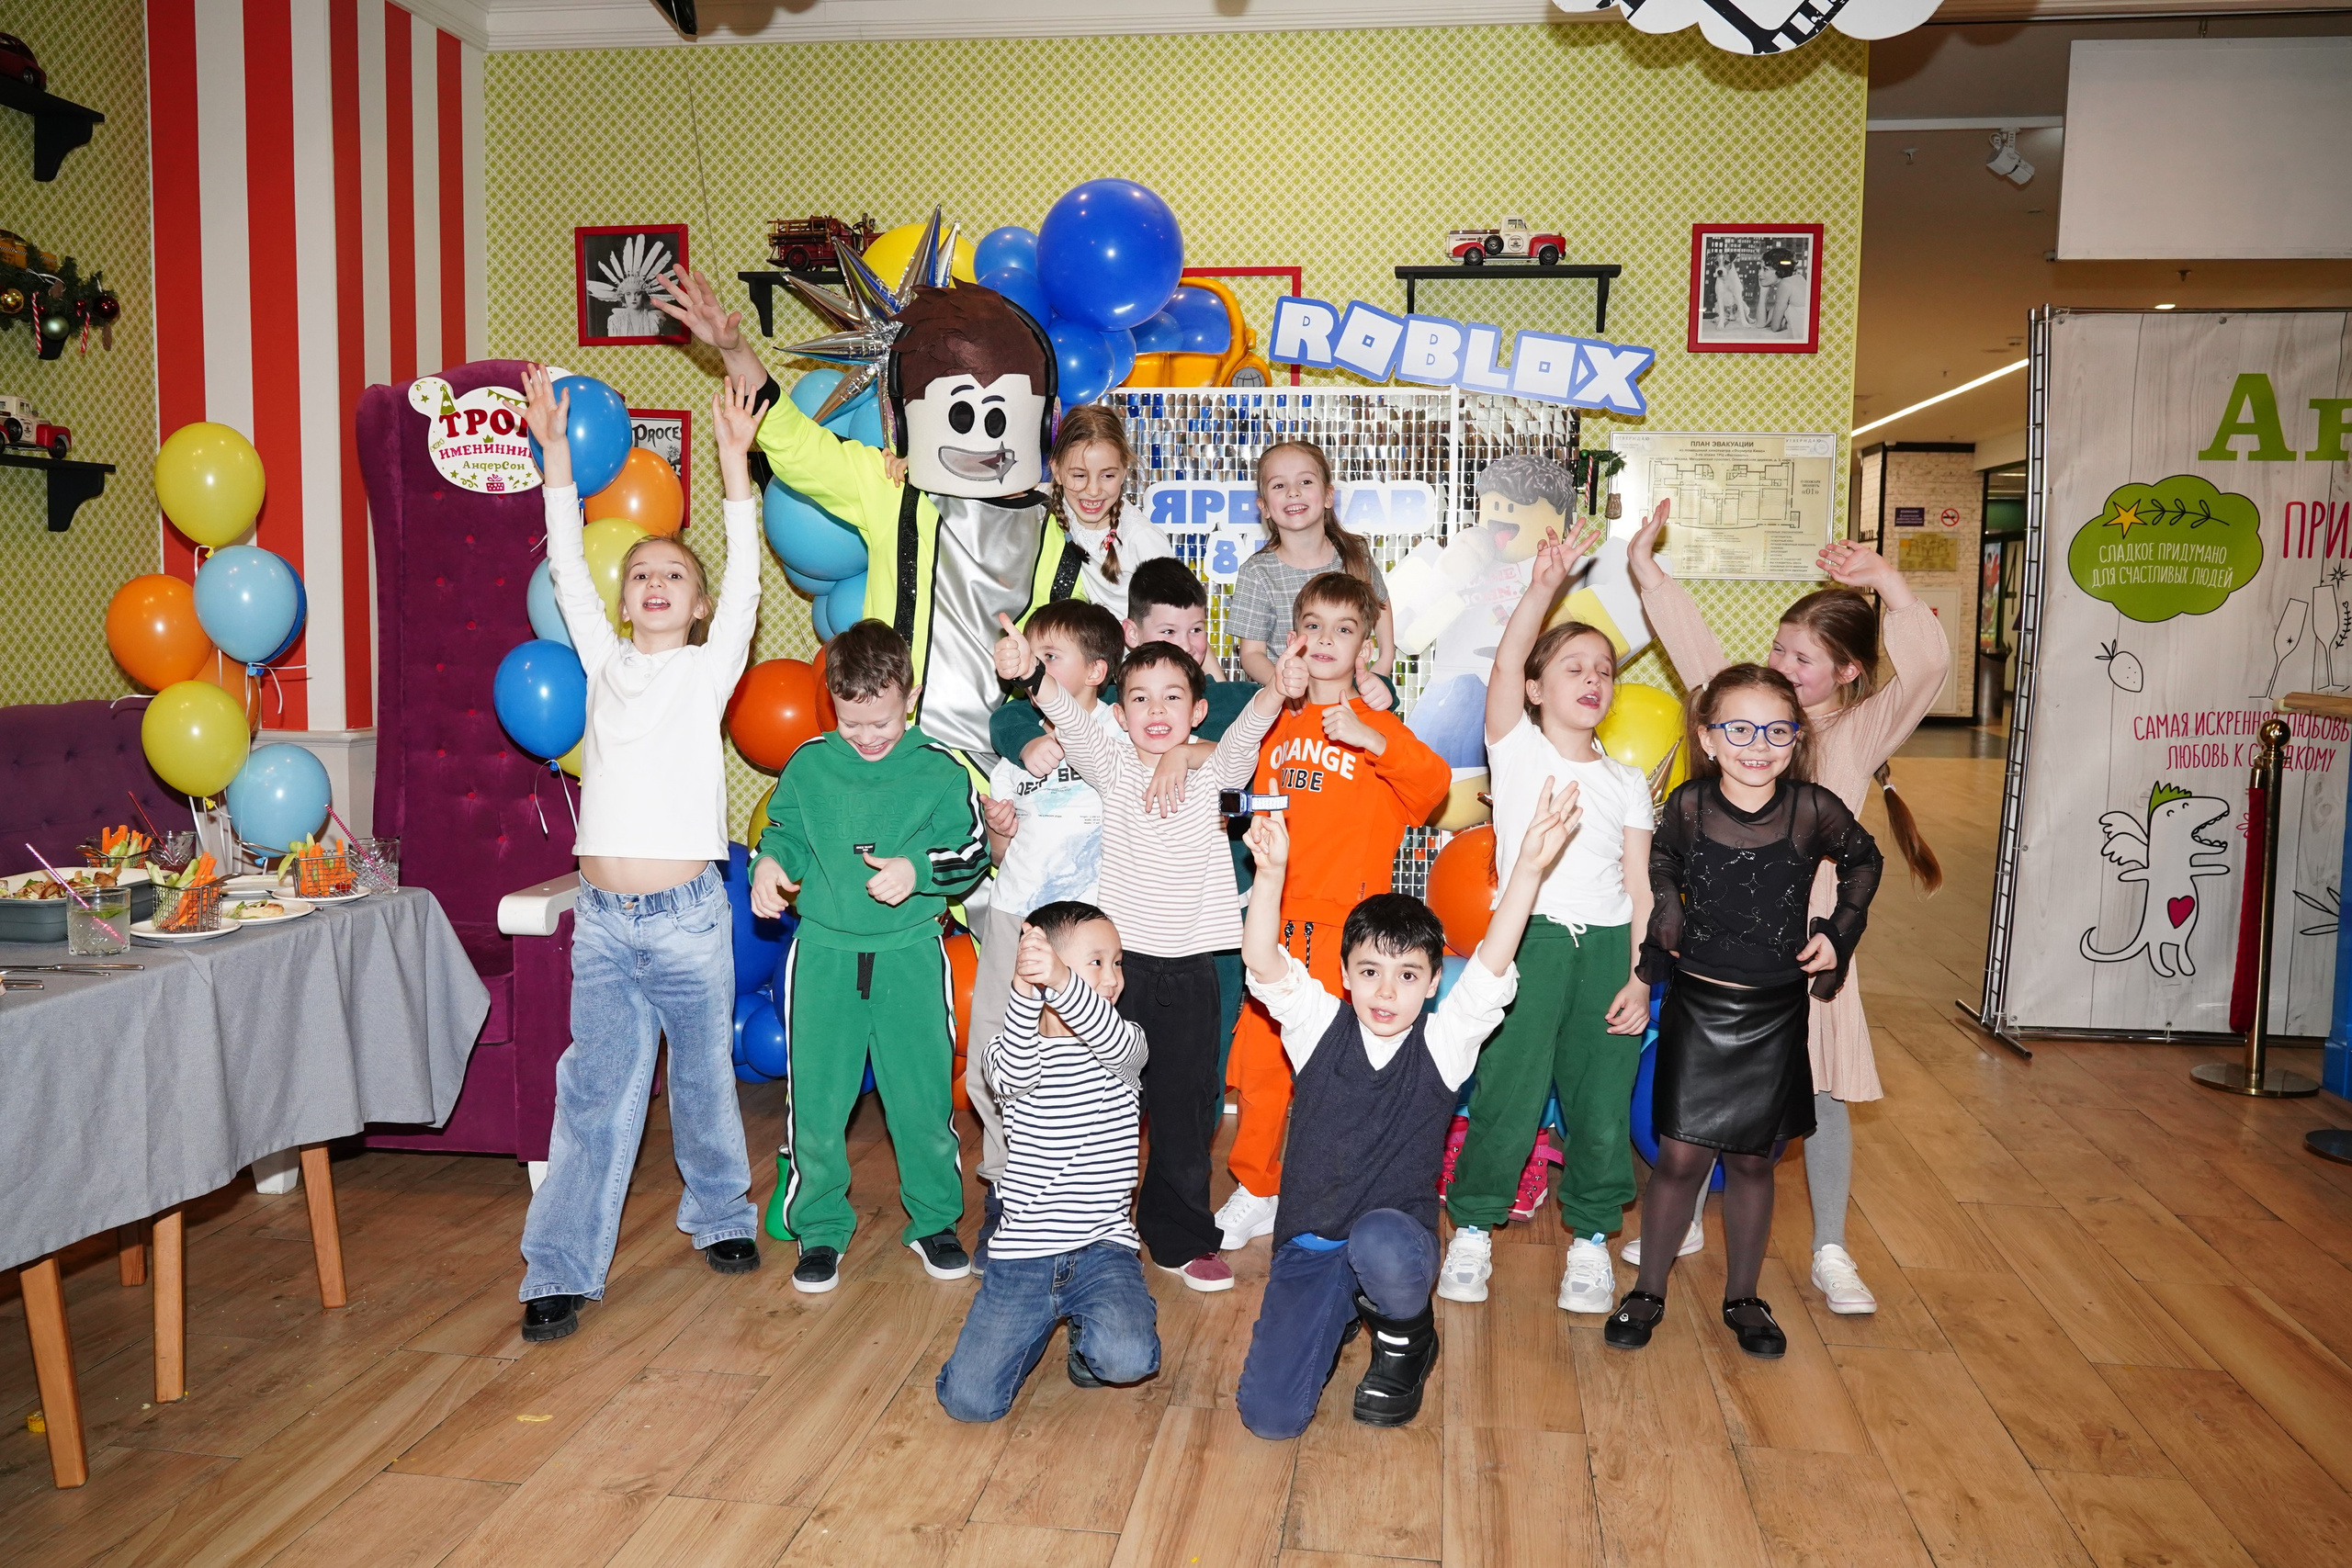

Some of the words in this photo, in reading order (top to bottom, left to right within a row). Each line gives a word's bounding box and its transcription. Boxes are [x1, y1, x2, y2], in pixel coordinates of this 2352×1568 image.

[1273, 300, 1652, 411] ROBLOX
[632, 423, 682, 448] PROCE
[438, 444, 532, 459] ИМЕНИННИ
[462, 460, 525, 472] АндерСон
[2283, 501, 2352, 559] ПРИ
[1213, 540, 1238, 574] 8
[2098, 542, 2155, 564] СЛАДКОЕ
[2158, 542, 2227, 565] ПРИДУМАНО
[2091, 567, 2116, 589] ДЛЯ
[2119, 564, 2189, 585] СЧАСТЛИВЫХ
[2189, 566, 2234, 589] ЛЮДЕЙ
[2133, 712, 2188, 740] САМАЯ
[2286, 712, 2350, 742] ЛЮБОВЬ
[2166, 743, 2229, 771] ЛЮБОВЬ
[2233, 742, 2245, 768] К
[2248, 743, 2336, 773] СДКОМУ
[1281, 768, 1324, 793] VIBE
